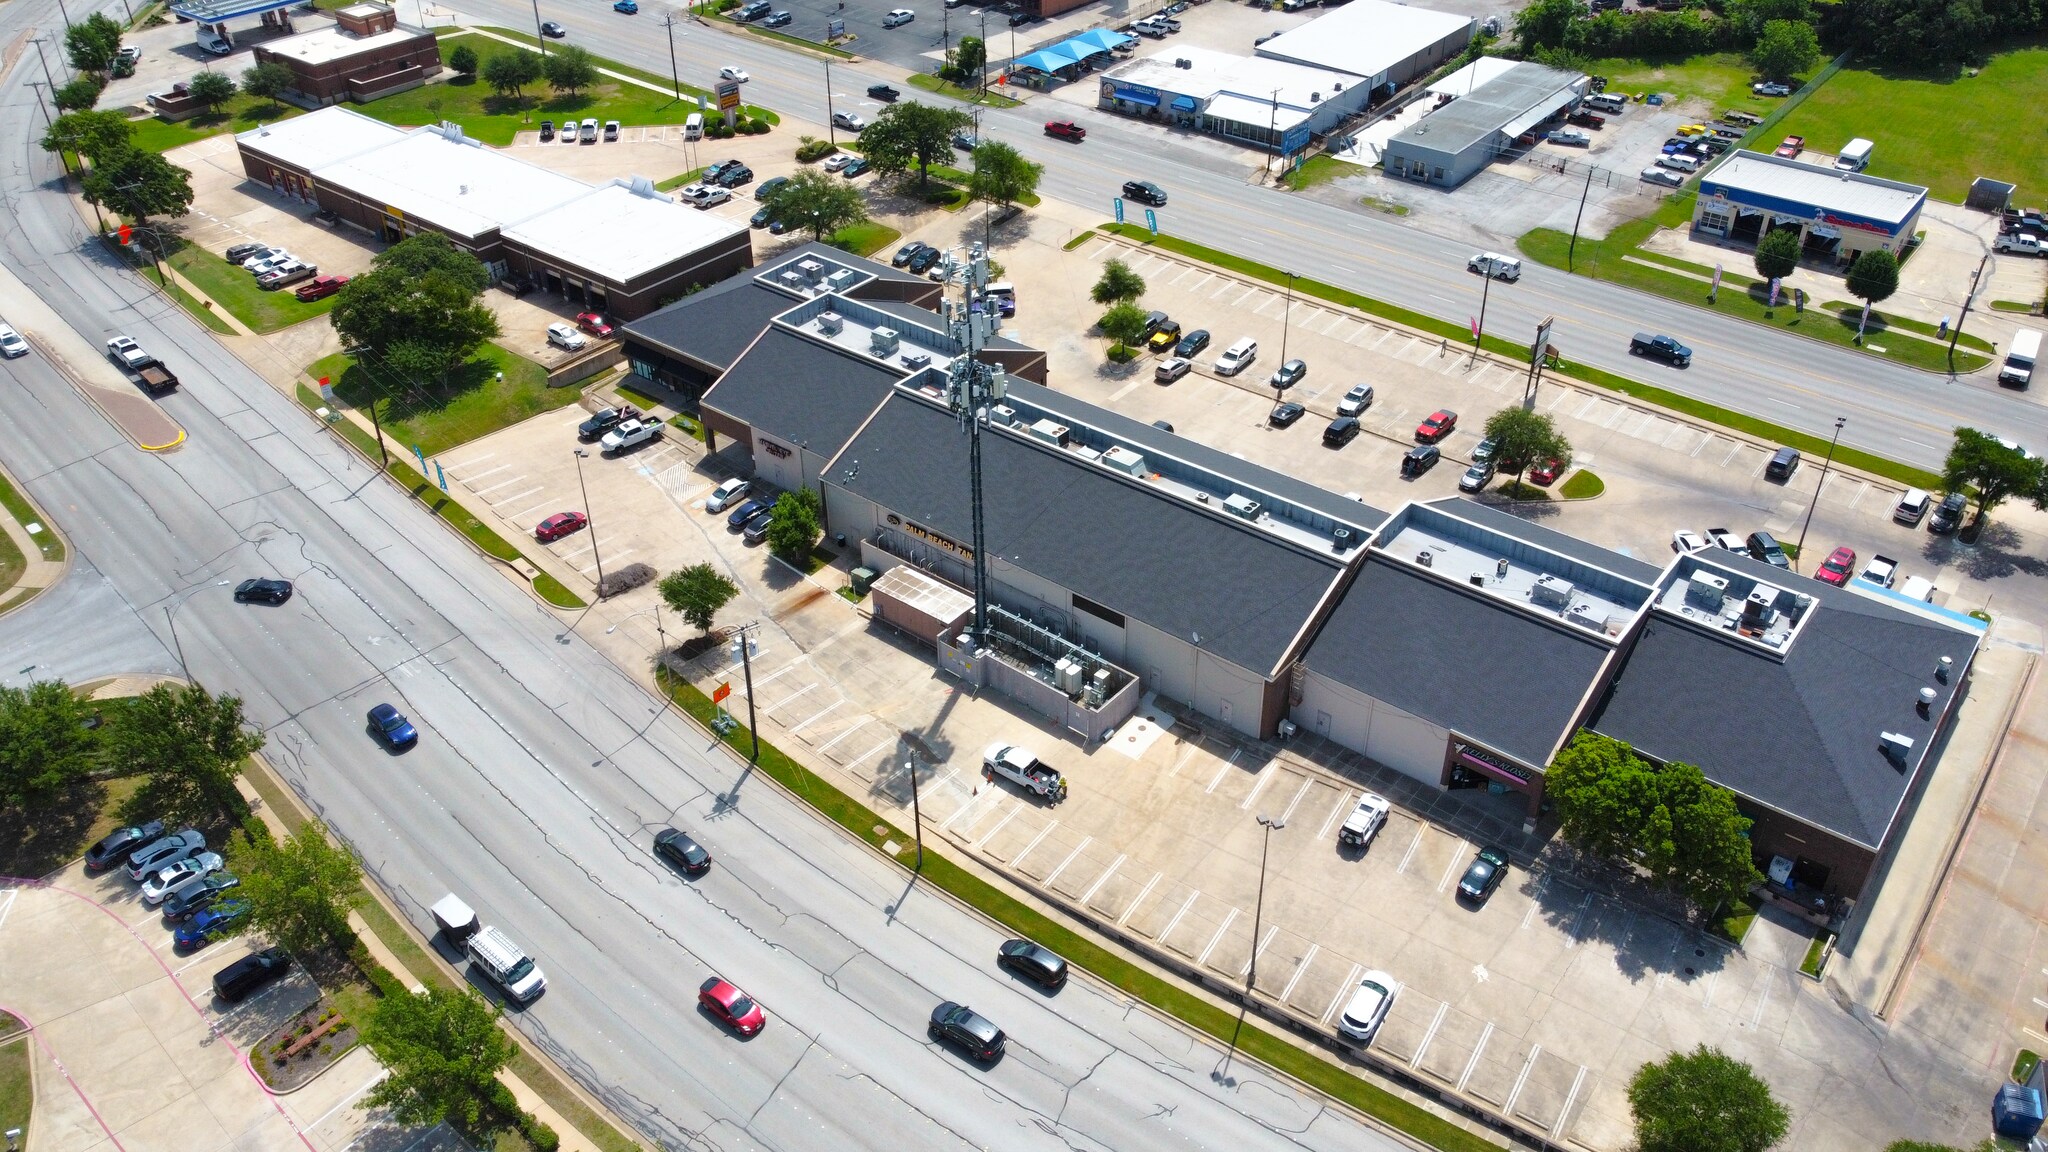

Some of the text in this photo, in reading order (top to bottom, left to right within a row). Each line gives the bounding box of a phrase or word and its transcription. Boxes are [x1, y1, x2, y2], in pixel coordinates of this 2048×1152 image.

[905, 522, 974, 560] PALM BEACH TAN
[1500, 762, 1533, 781] KLOSET
